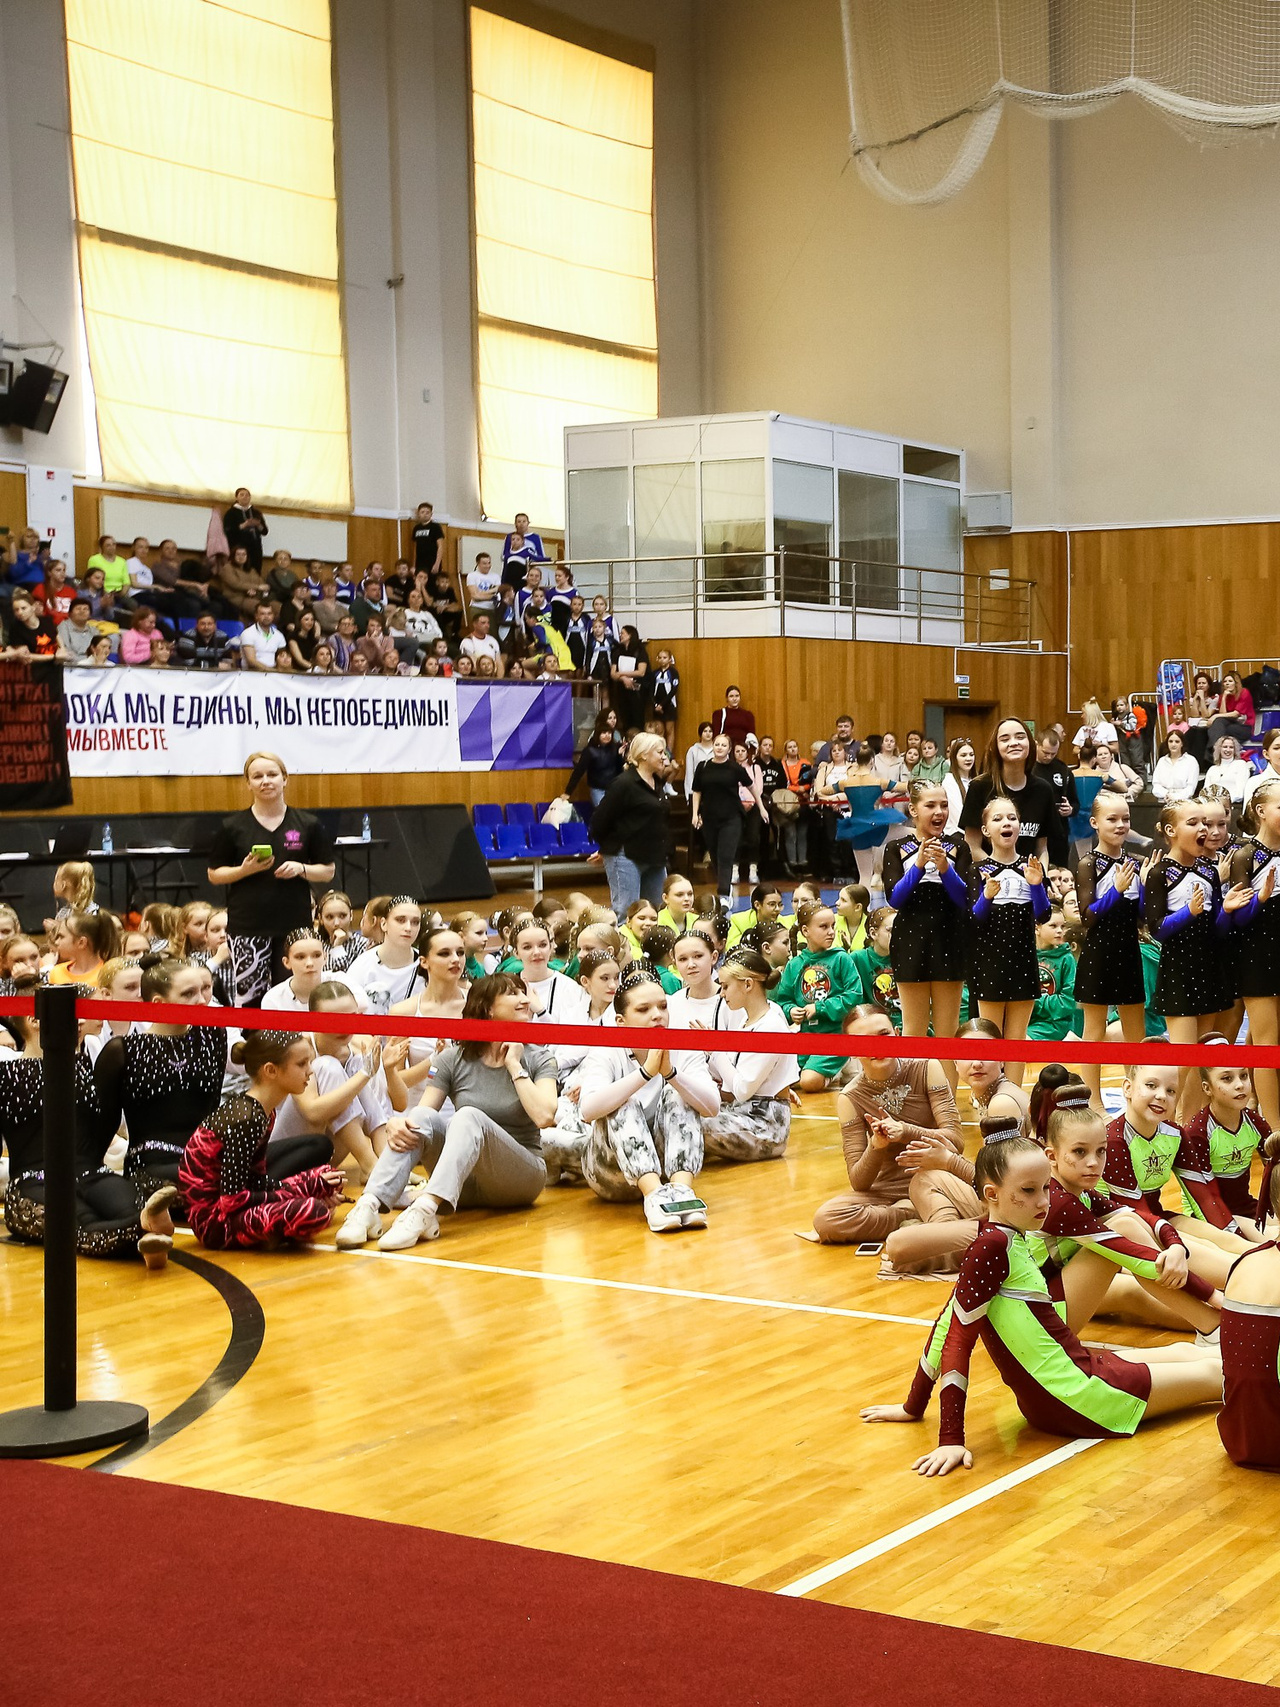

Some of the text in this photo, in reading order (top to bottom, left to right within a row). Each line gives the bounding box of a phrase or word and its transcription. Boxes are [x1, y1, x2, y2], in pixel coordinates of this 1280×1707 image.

[125, 692, 165, 725] МЫ
[173, 695, 259, 729] ЕДИНЫ,
[265, 696, 302, 726] МЫ
[307, 698, 449, 730] НЕПОБЕДИМЫ!
